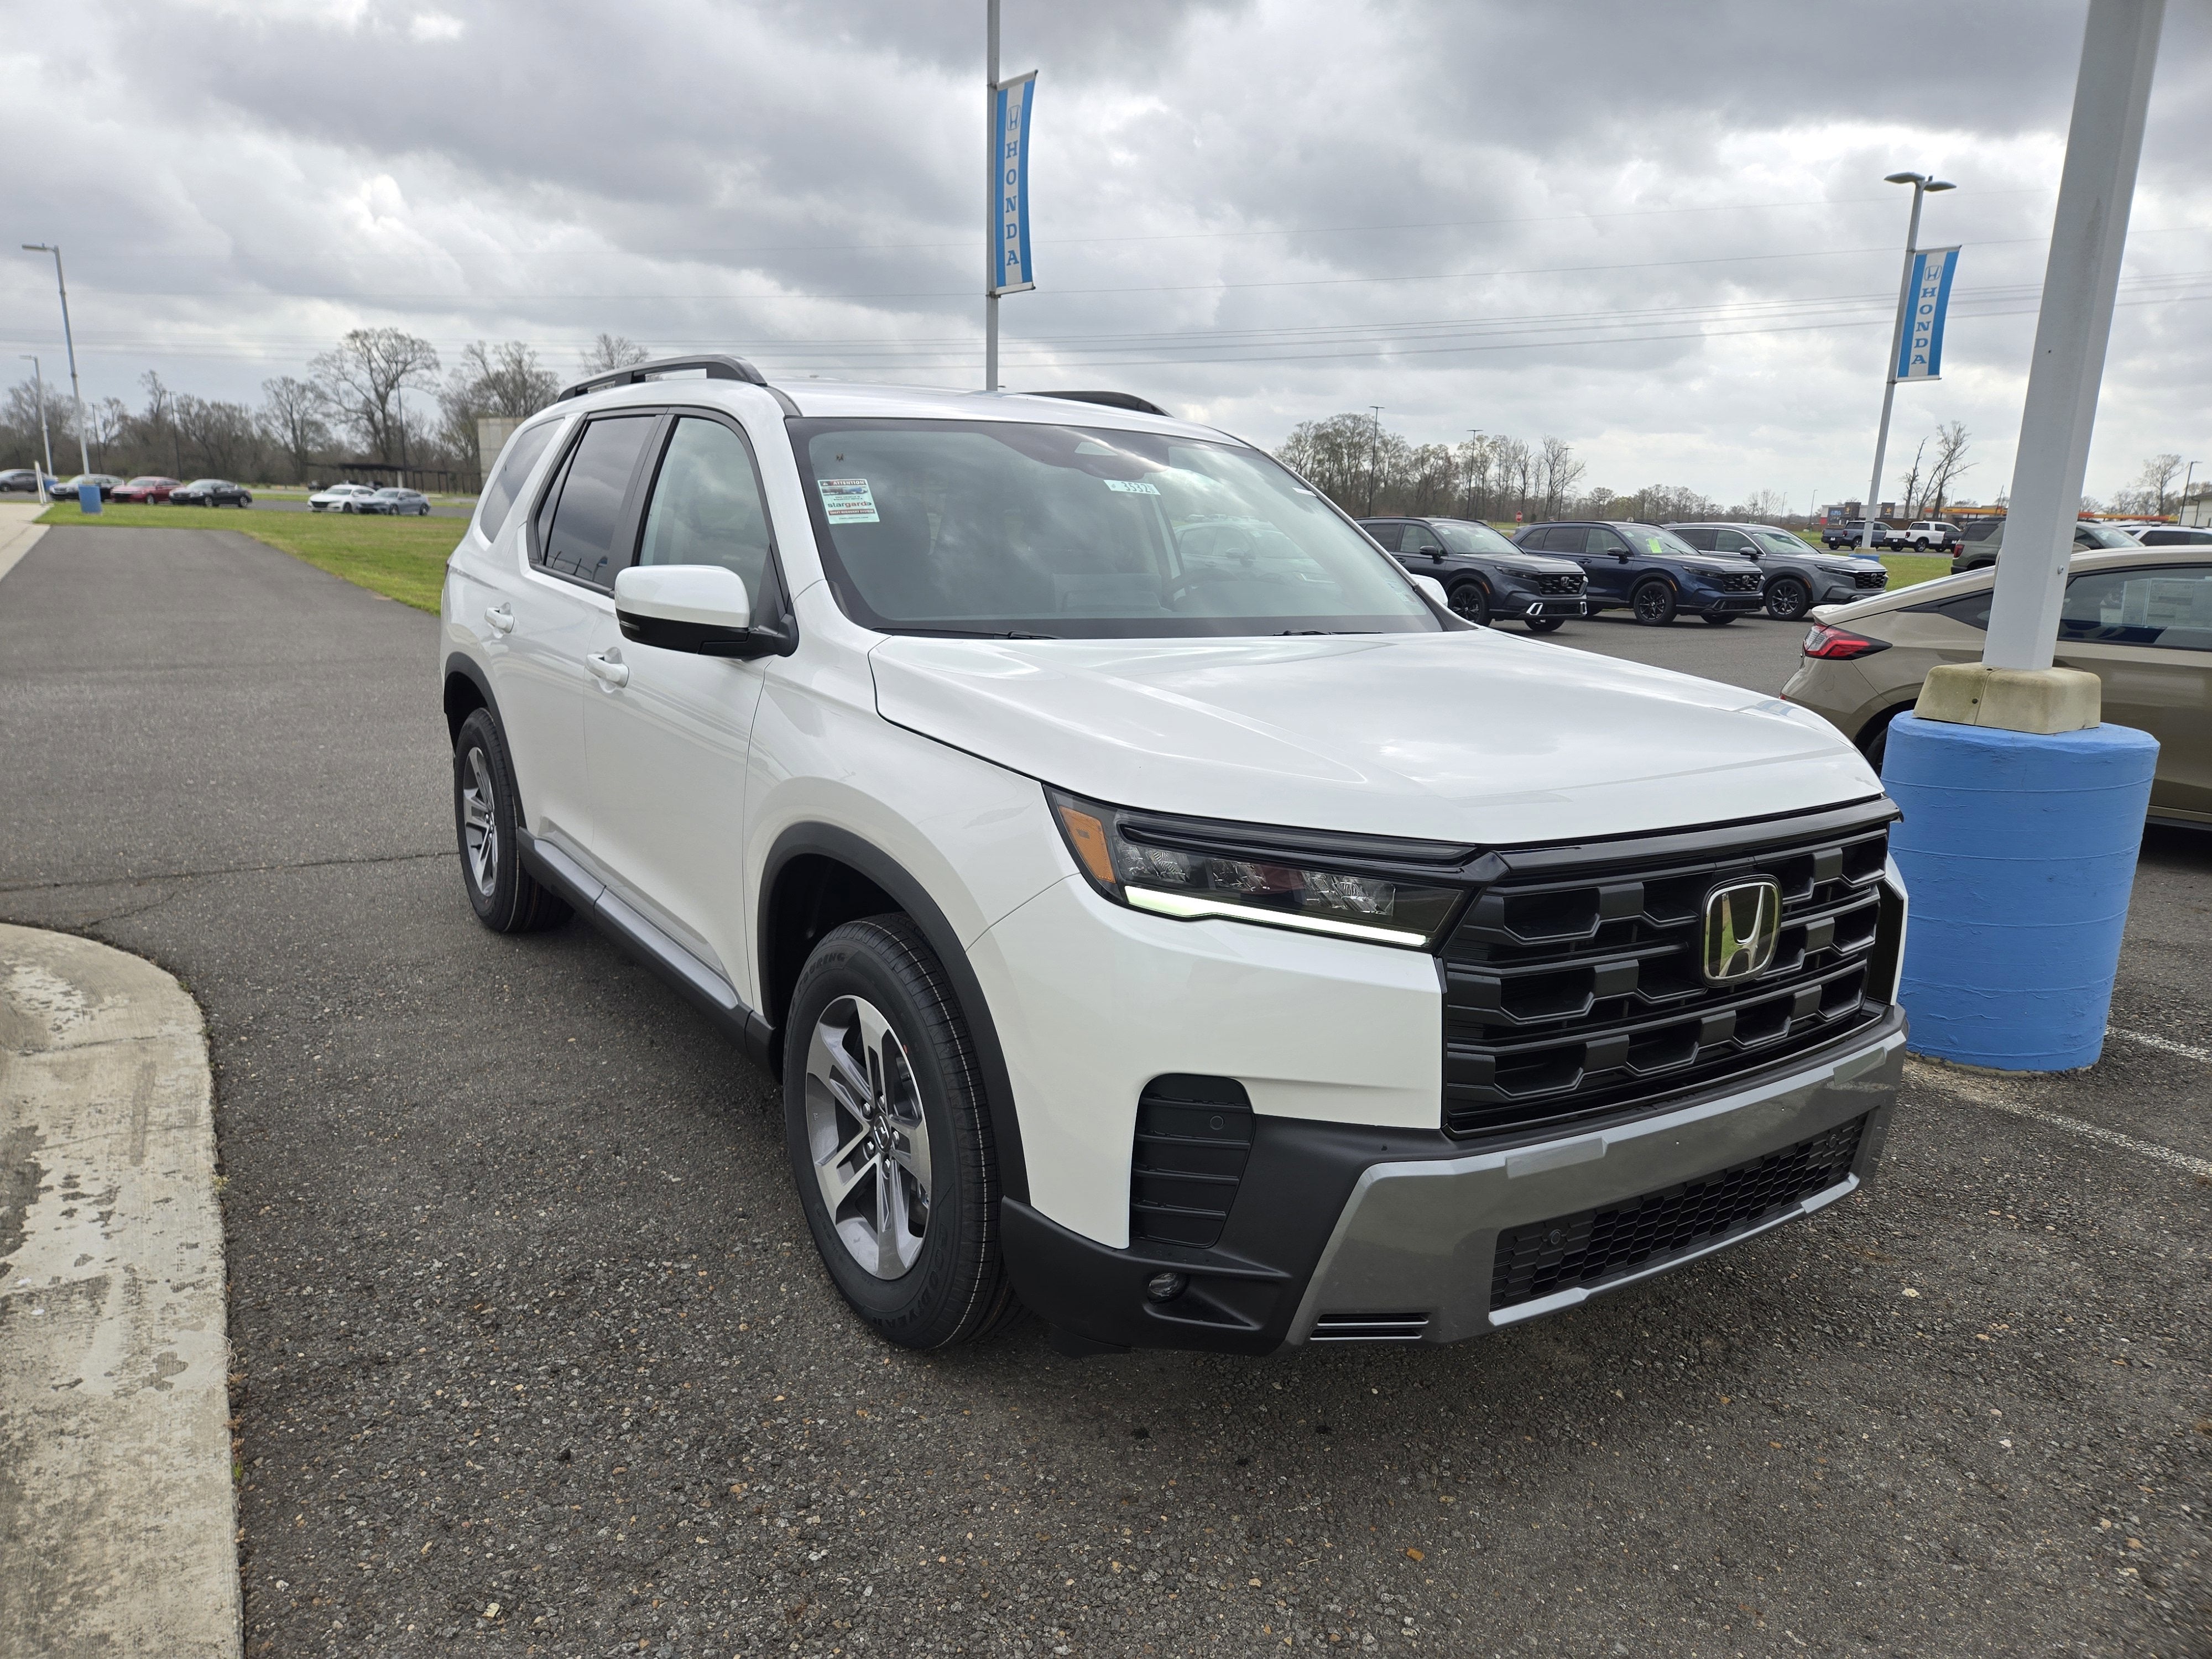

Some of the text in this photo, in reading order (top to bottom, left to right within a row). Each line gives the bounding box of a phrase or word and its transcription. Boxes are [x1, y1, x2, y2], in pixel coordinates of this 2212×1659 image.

[1005, 140, 1019, 266] HONDA
[1911, 287, 1937, 364] HONDA
[1121, 482, 1151, 493] 3532
